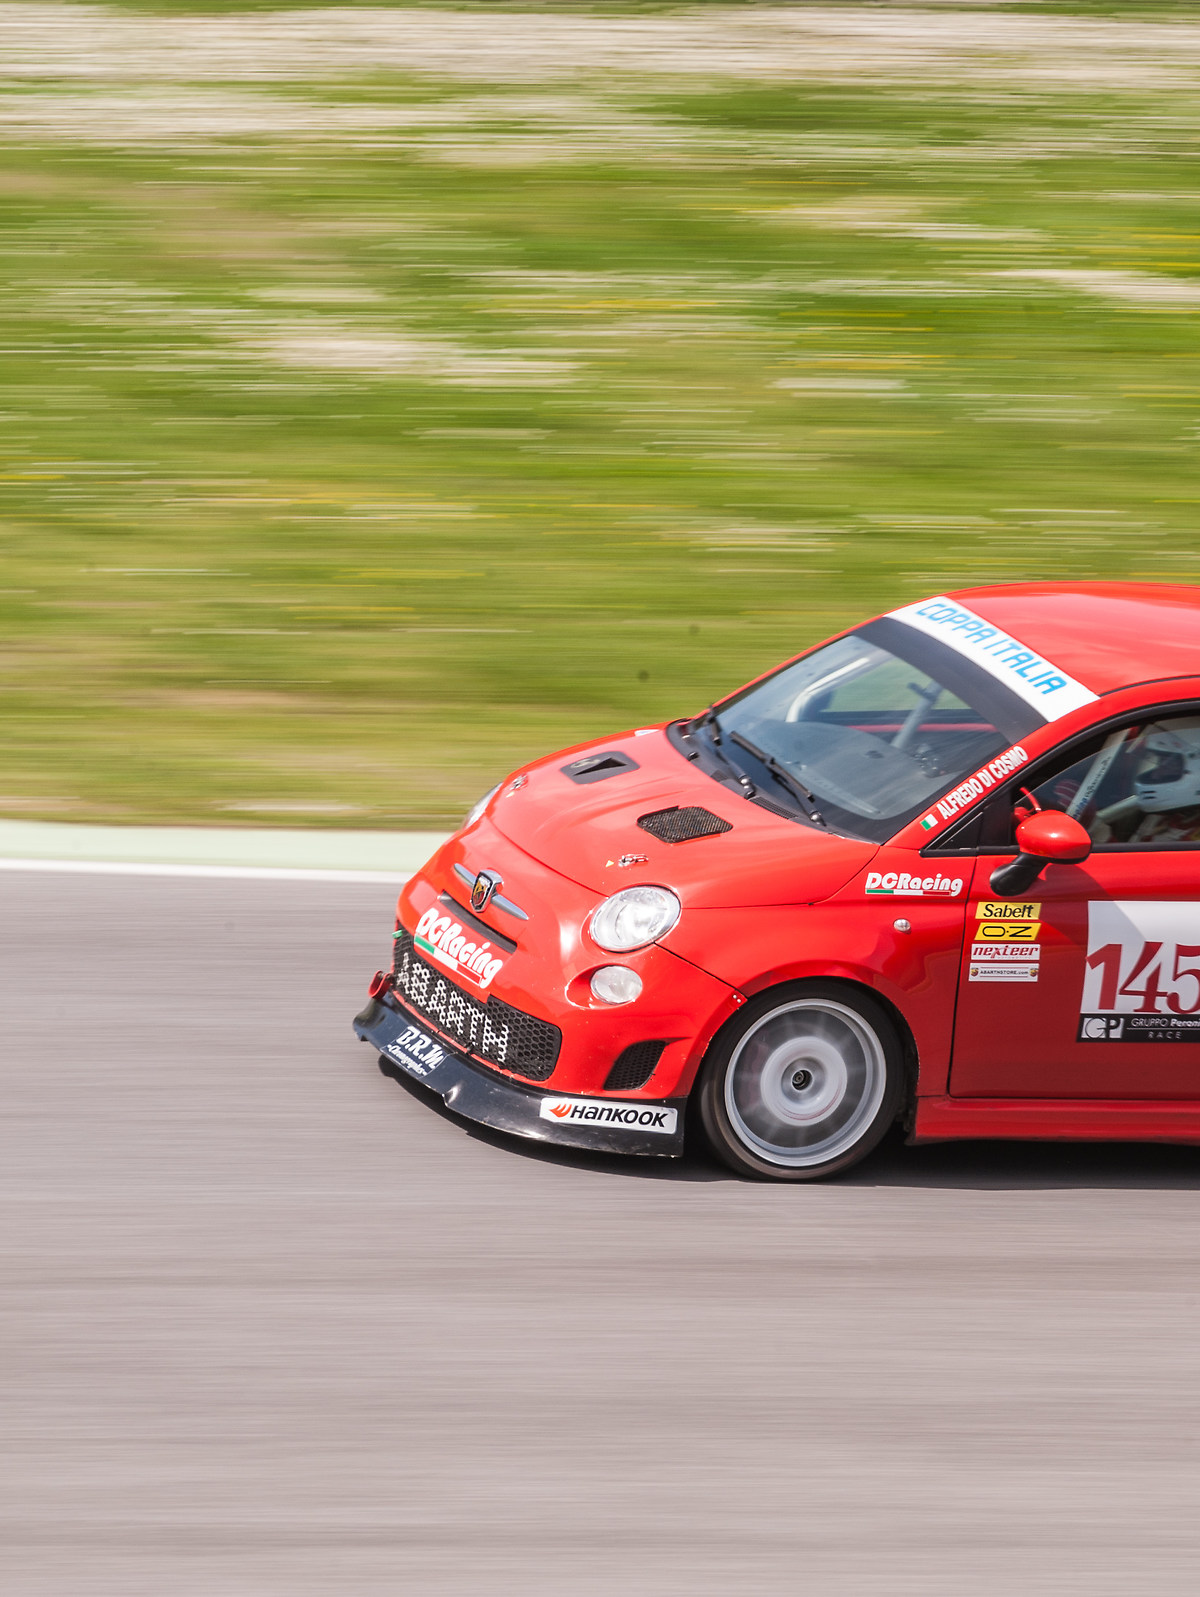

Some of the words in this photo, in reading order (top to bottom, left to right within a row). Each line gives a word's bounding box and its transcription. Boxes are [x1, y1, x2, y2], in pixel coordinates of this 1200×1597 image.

[915, 603, 998, 644] COPPA
[983, 638, 1068, 695] ITALIA
[936, 777, 984, 820] ALFREDO
[976, 768, 996, 788] DI
[988, 745, 1029, 779] COSMO
[865, 872, 963, 897] DCRacing
[983, 903, 1034, 918] Sabelt
[415, 907, 503, 989] DCRacing
[973, 944, 1039, 959] nexteer
[1131, 1018, 1168, 1028] GRUPPO
[1147, 1031, 1183, 1040] RACE
